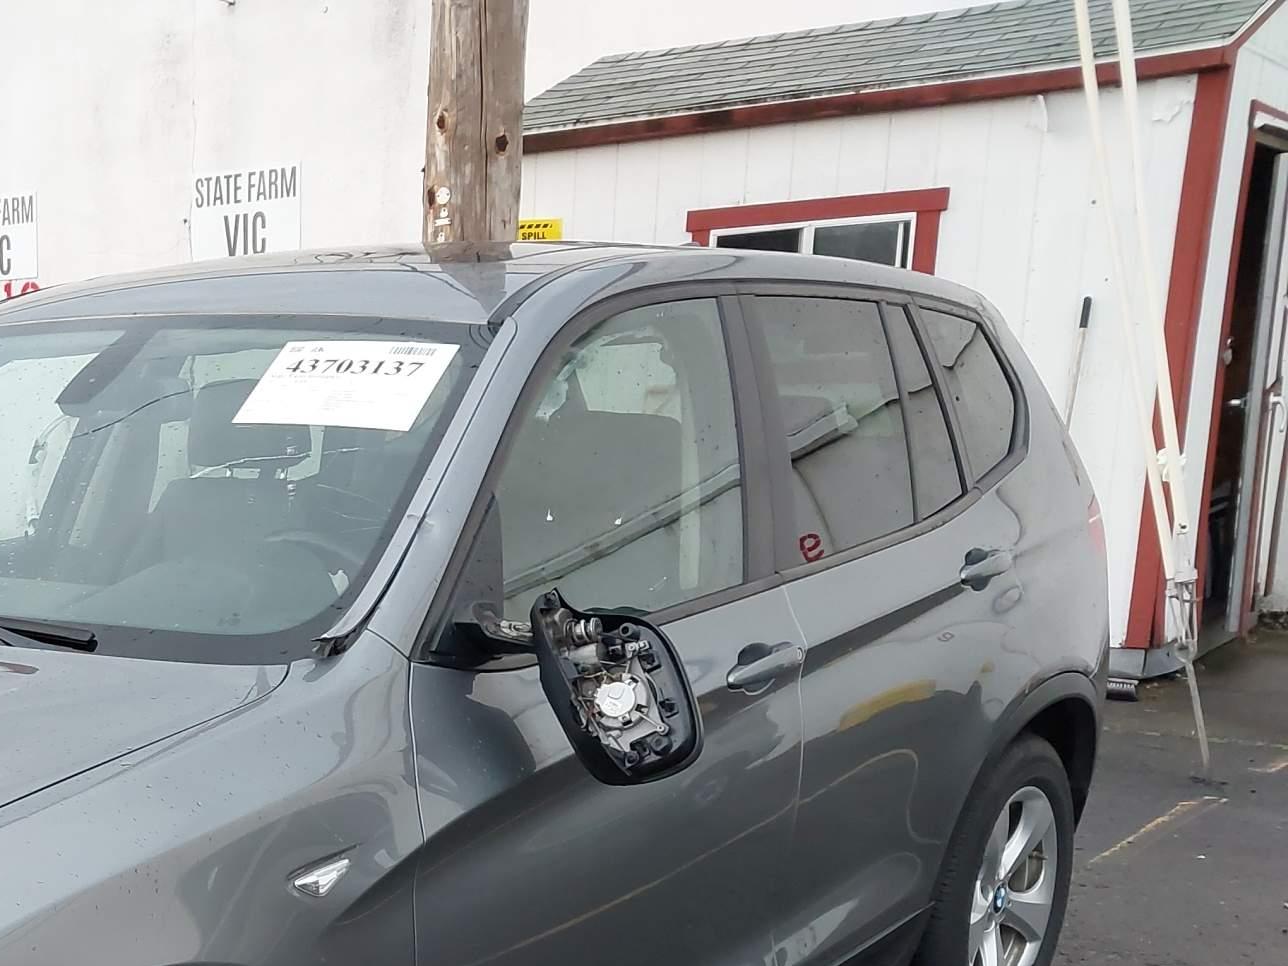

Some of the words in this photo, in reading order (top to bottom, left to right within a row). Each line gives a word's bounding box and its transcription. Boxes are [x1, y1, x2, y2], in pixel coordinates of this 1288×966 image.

[195, 173, 242, 208] STATE
[248, 166, 296, 202] FARM
[224, 211, 266, 256] VIC
[521, 231, 546, 240] SPILL
[285, 358, 425, 377] 43703137
